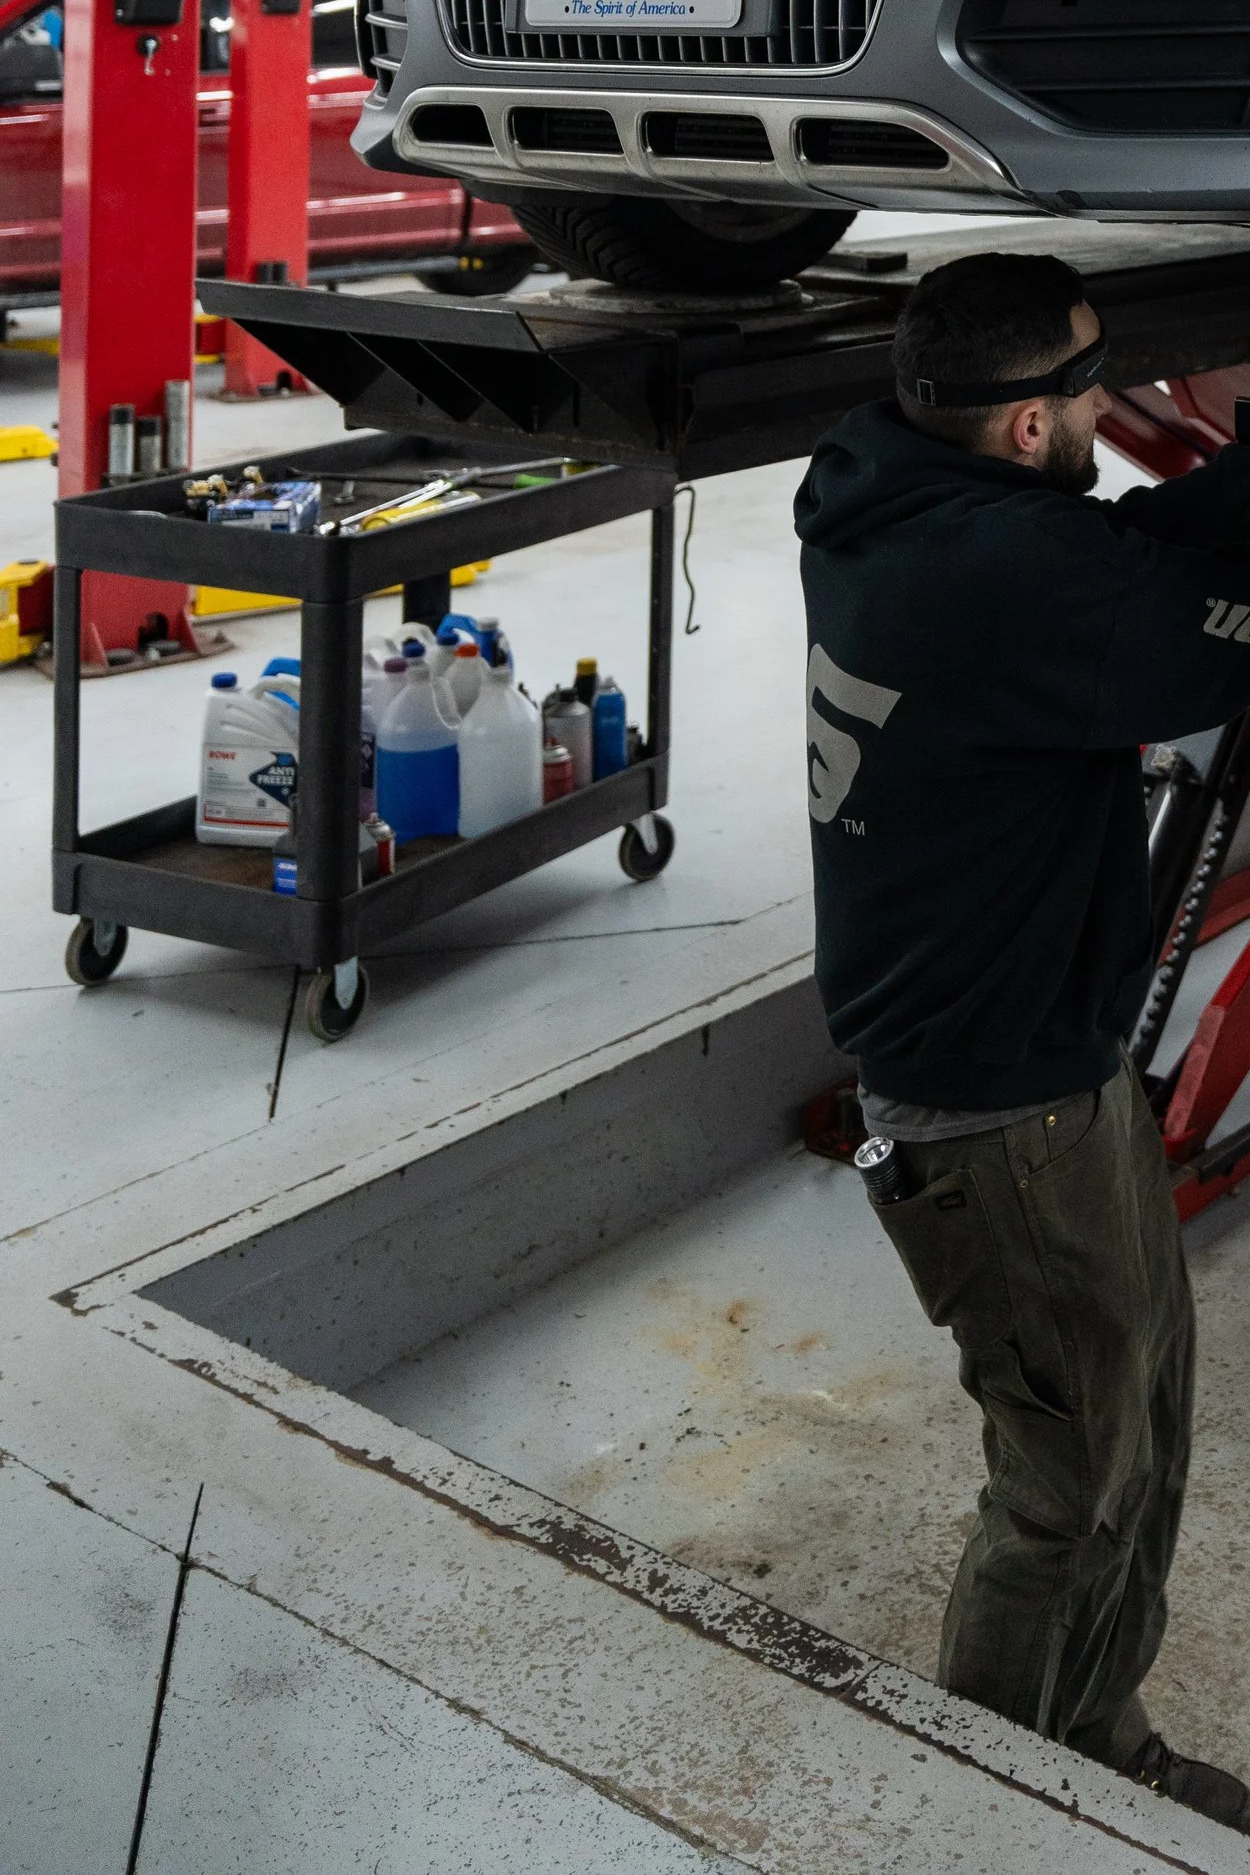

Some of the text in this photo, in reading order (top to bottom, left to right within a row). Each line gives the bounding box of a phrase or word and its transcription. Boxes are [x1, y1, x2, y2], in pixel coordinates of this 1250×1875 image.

[571, 0, 686, 17] The Spirit of America
[257, 774, 294, 785] FREEZE
[841, 818, 866, 836] TM
